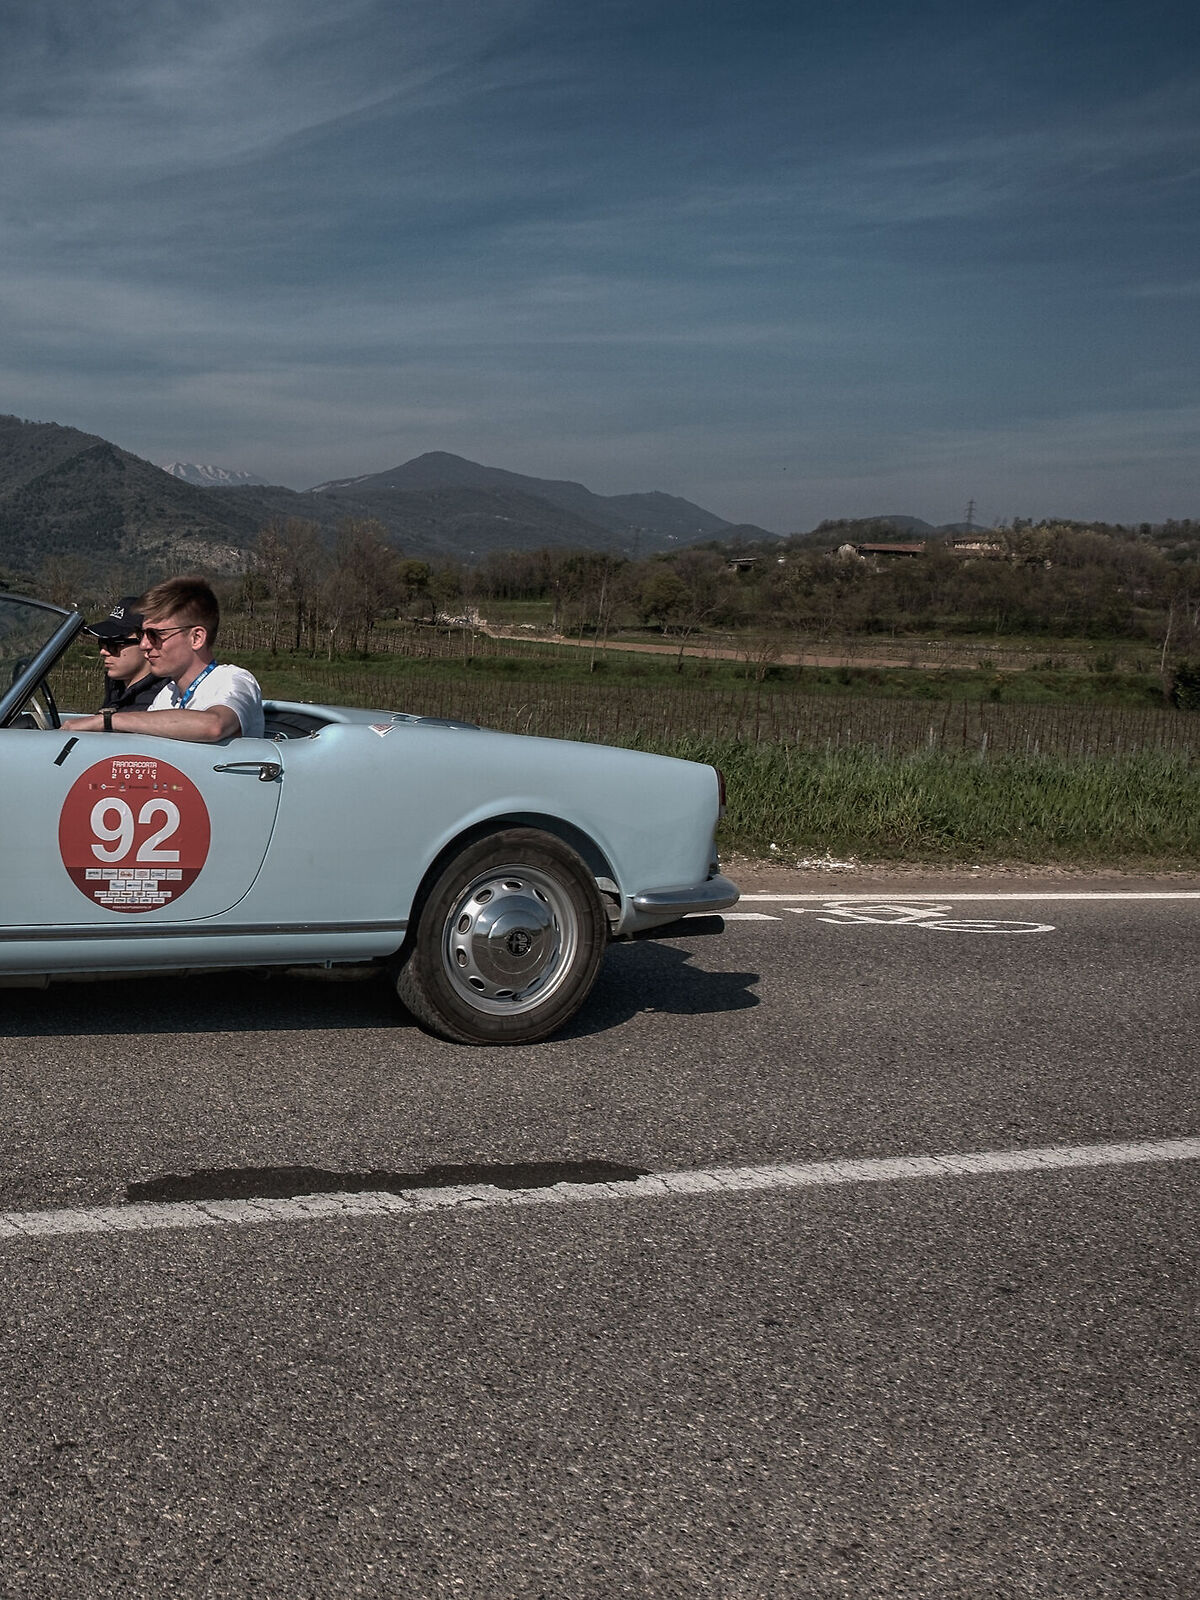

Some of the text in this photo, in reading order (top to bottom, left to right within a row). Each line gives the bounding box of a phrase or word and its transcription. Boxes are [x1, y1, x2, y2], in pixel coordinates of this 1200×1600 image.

[112, 760, 158, 768] FRANCIACORTA
[111, 767, 157, 775] historic
[89, 797, 181, 863] 92
